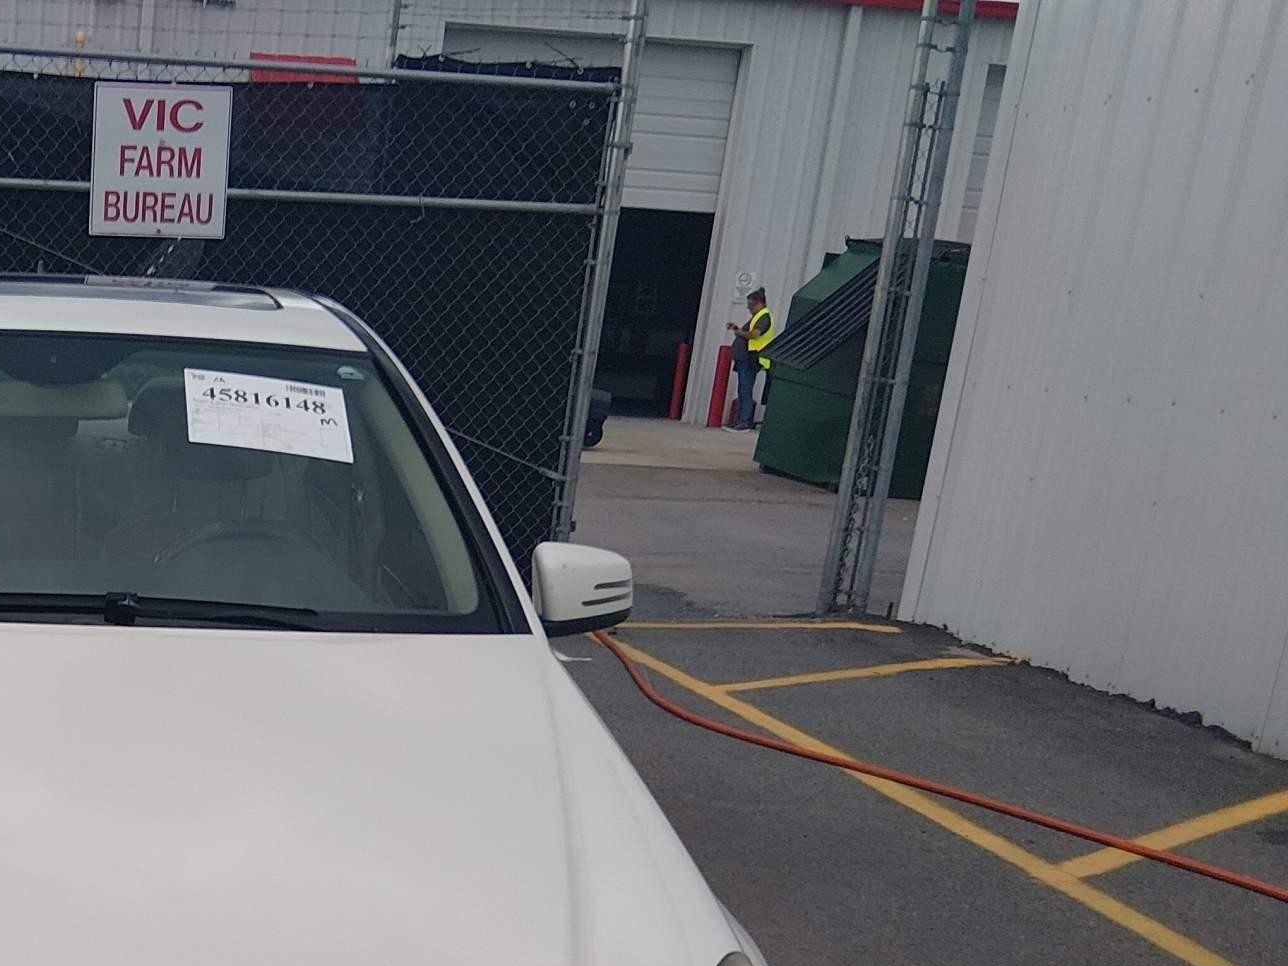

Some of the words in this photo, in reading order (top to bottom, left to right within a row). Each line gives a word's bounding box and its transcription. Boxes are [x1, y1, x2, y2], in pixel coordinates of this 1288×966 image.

[123, 98, 205, 133] VIC
[119, 145, 202, 179] FARM
[103, 190, 214, 225] BUREAU
[202, 387, 327, 415] 45816148
